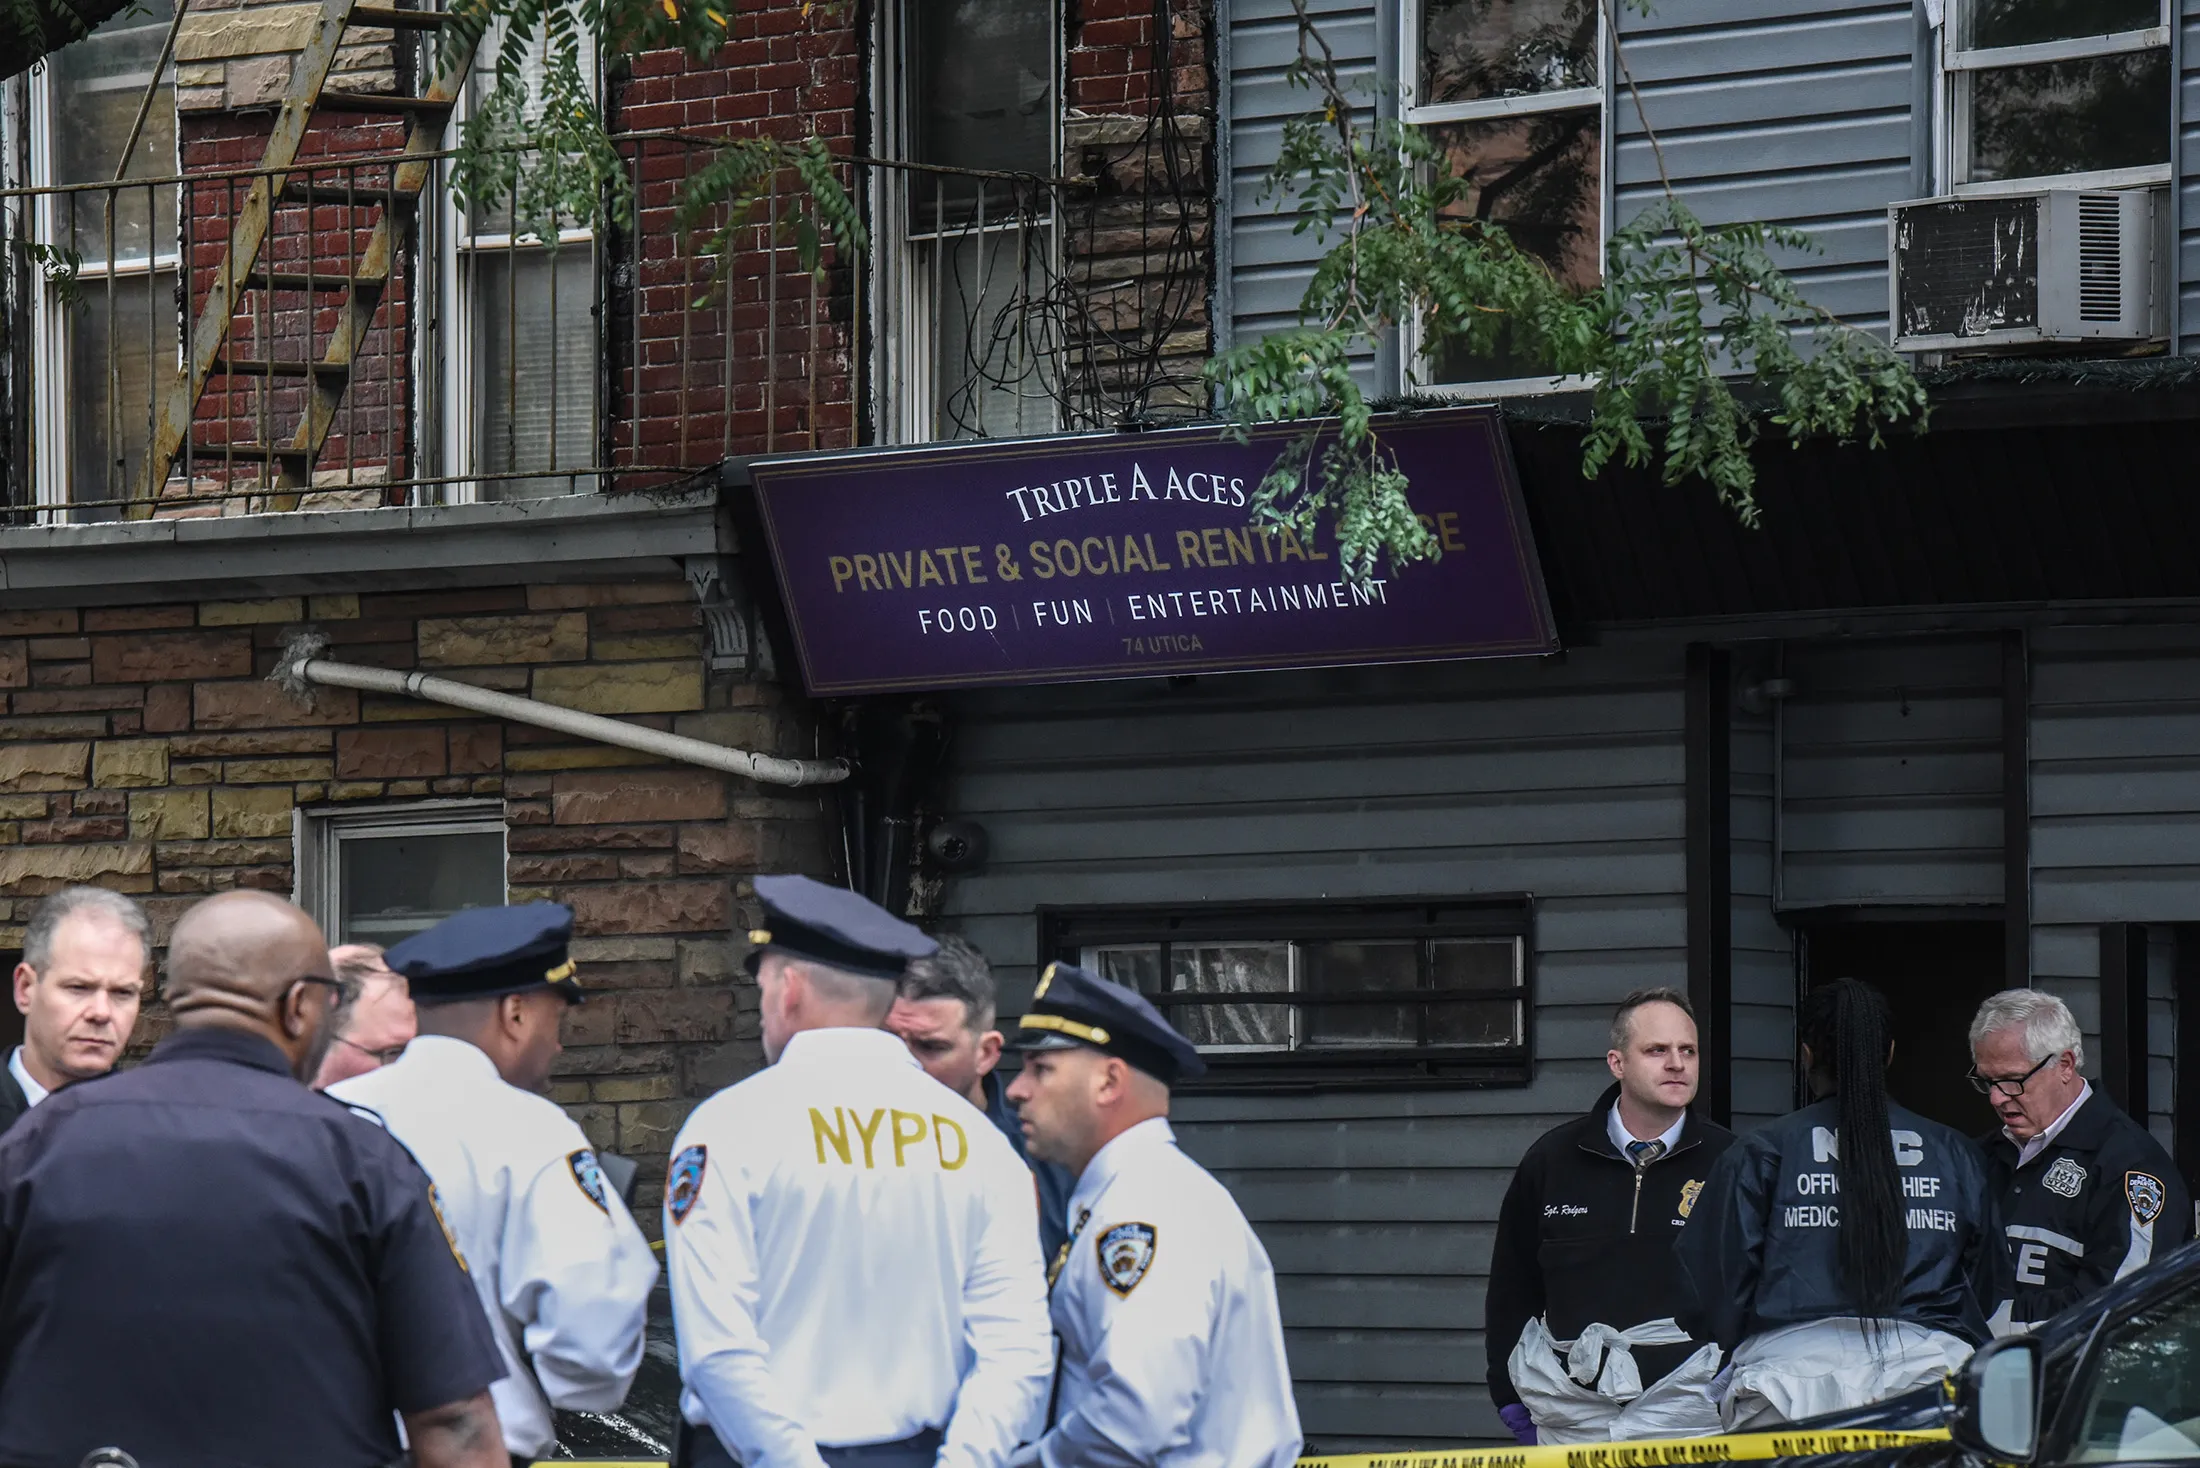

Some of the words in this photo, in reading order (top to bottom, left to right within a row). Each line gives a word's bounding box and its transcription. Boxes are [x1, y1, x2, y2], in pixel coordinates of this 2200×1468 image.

[1006, 473, 1121, 523] TRIPLE
[1129, 462, 1159, 501] A
[1164, 466, 1246, 508] ACES
[829, 545, 989, 593] PRIVATE
[995, 543, 1024, 582] &
[1029, 533, 1171, 579] SOCIAL
[1176, 524, 1329, 570] RENTAL
[918, 605, 998, 634] FOOD
[1033, 598, 1093, 627] FUN
[1127, 579, 1388, 621] ENTERTAINMENT
[1122, 637, 1145, 655] 74
[1148, 633, 1204, 654] UTICA
[807, 1106, 969, 1171] NYPD
[1812, 1126, 1924, 1166] NC
[1797, 1173, 1840, 1196] OFFI
[1901, 1176, 1941, 1198] HIEF
[1784, 1206, 1840, 1228] MEDIC
